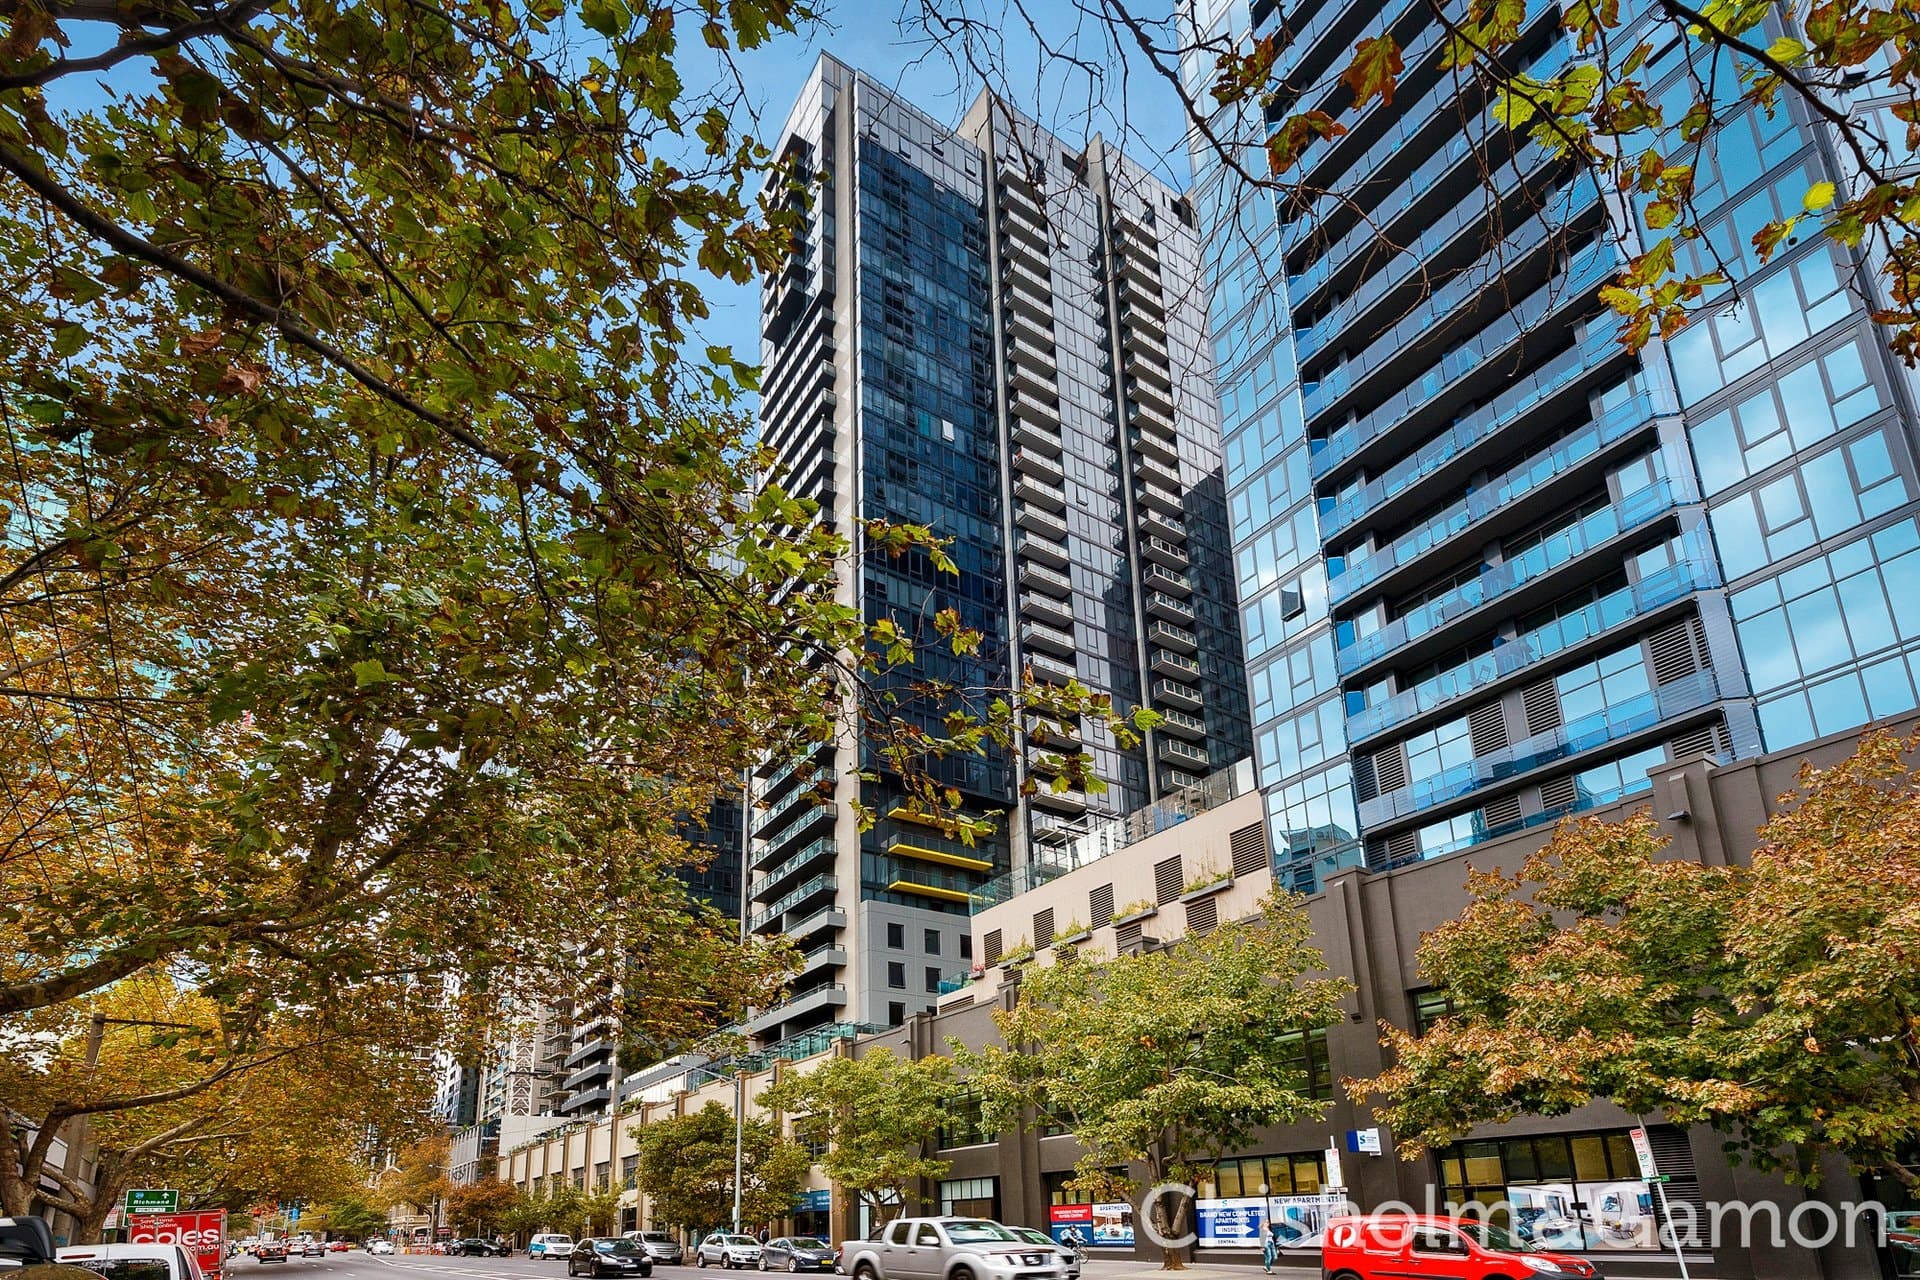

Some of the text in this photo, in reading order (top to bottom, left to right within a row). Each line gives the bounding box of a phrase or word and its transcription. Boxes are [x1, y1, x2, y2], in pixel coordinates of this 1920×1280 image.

[1274, 1195, 1339, 1205] NEW APARTMENTS
[132, 1227, 219, 1245] coles
